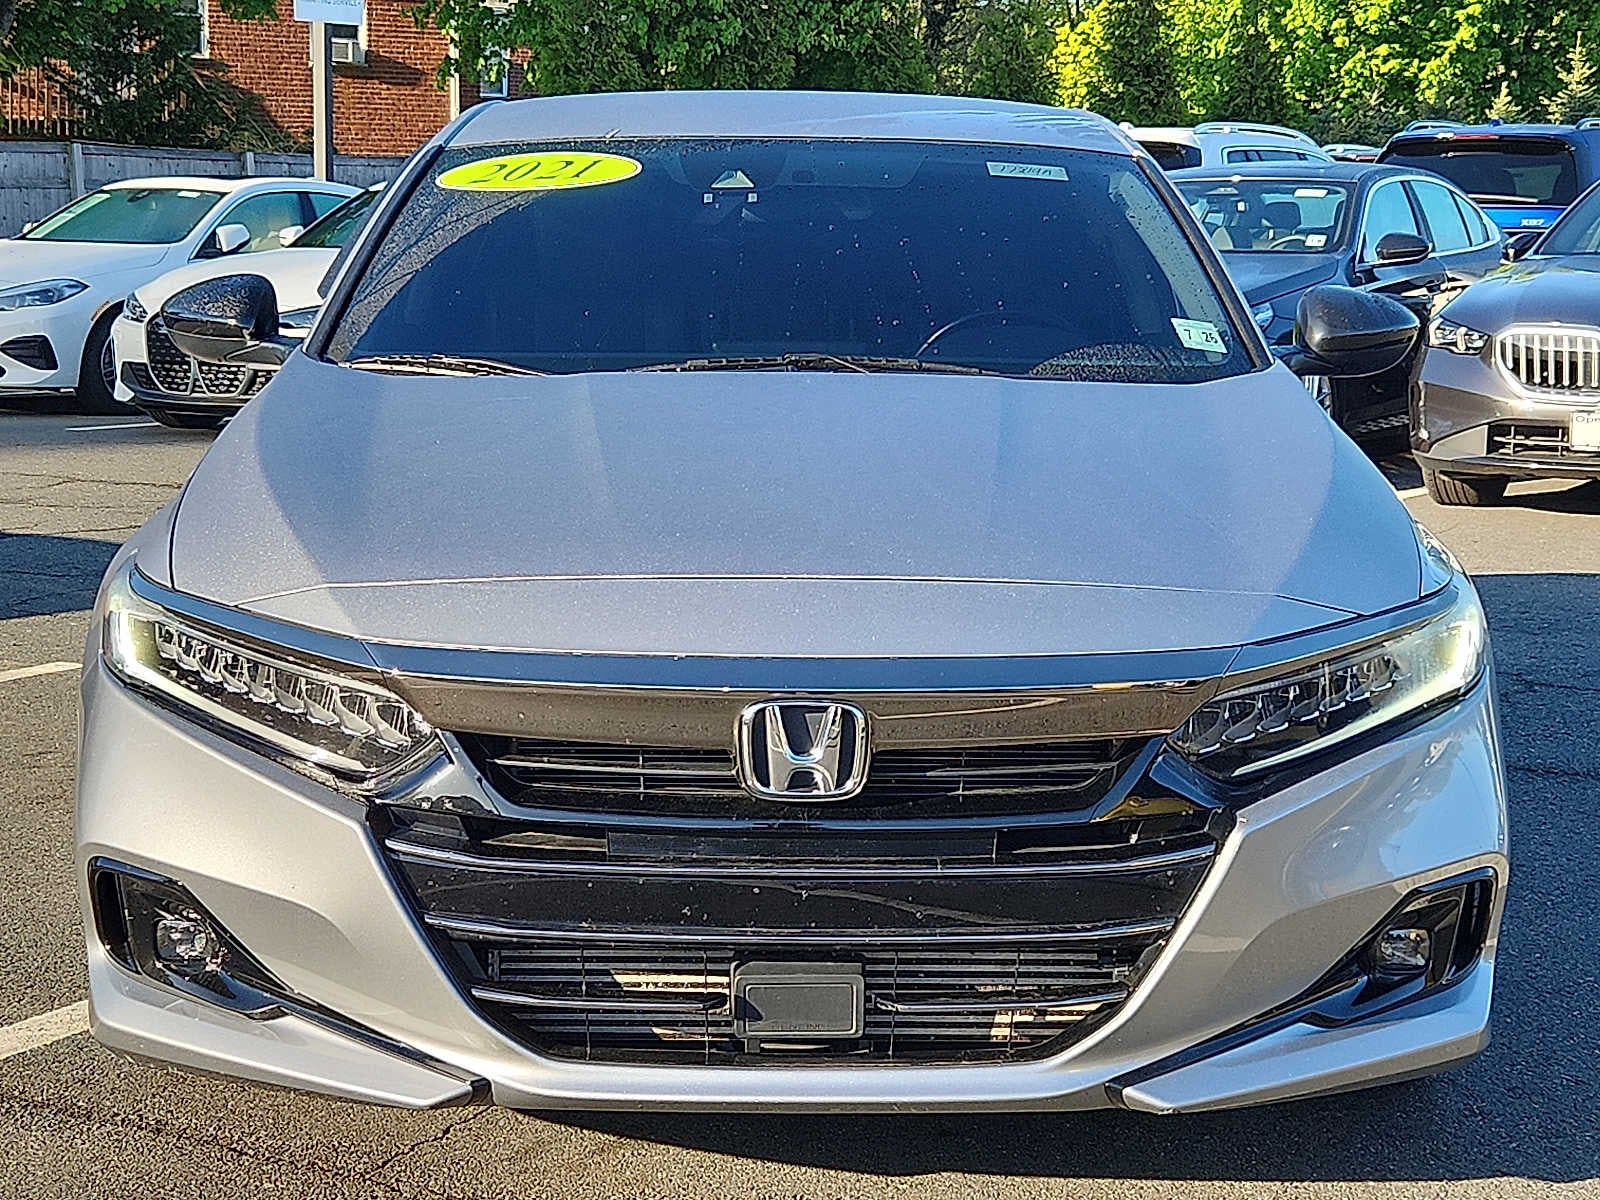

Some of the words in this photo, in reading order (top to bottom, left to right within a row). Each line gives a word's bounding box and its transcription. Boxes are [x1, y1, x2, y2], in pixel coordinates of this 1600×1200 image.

[467, 159, 604, 185] 2021
[1183, 328, 1192, 340] 7
[1201, 331, 1218, 344] 25
